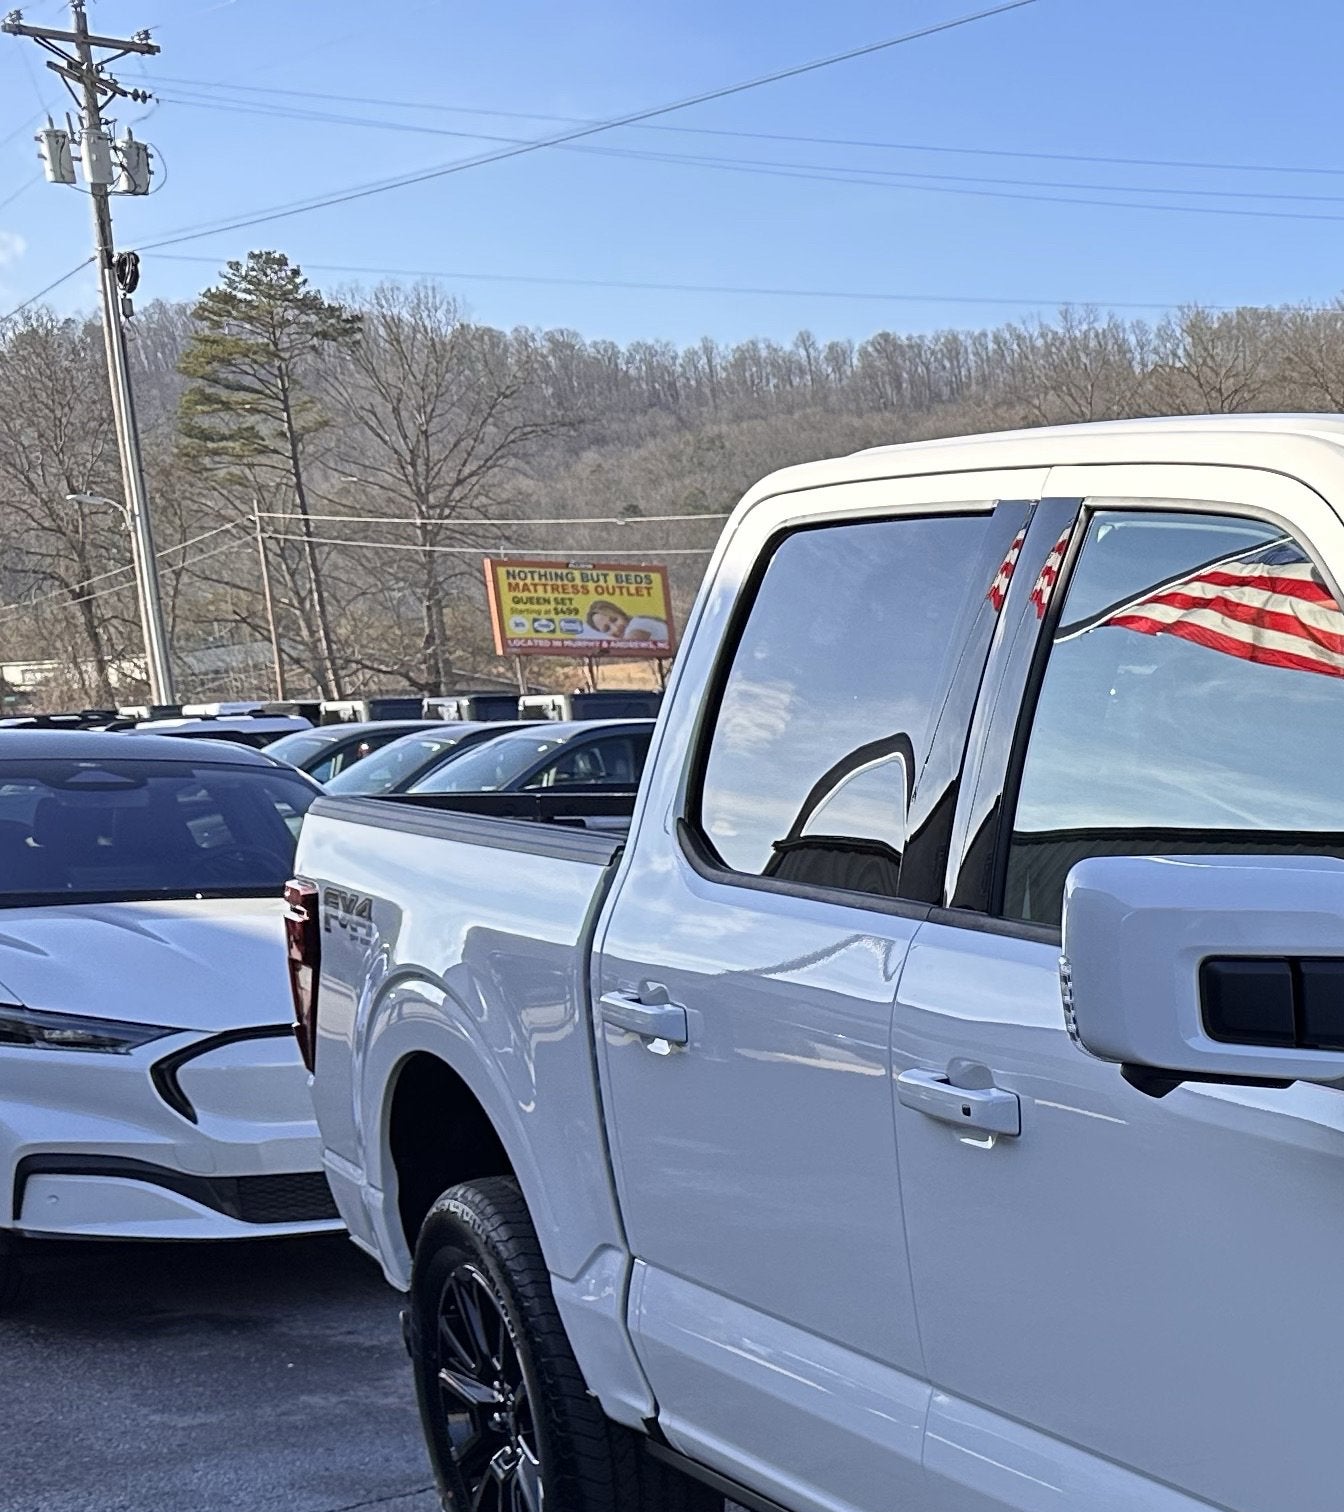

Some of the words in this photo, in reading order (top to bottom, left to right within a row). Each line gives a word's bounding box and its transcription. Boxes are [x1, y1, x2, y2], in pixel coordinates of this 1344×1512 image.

[505, 568, 576, 583] NOTHING
[580, 572, 609, 584] BUT
[615, 573, 654, 585] BEDS
[507, 582, 590, 595] MATTRESS
[594, 584, 654, 597] OUTLET
[511, 595, 551, 605] QUEEN
[553, 597, 575, 606] SET
[510, 606, 542, 616] Starting
[507, 640, 551, 648] LOCATED
